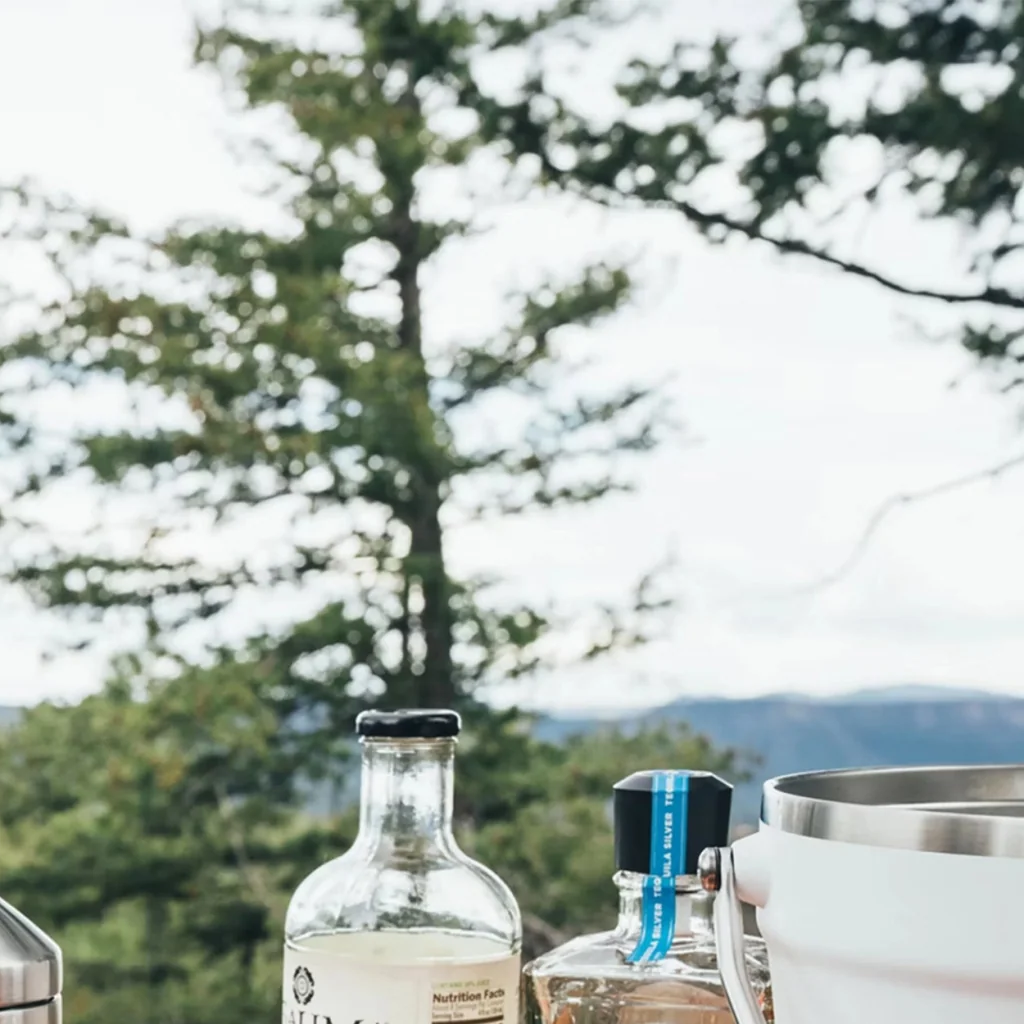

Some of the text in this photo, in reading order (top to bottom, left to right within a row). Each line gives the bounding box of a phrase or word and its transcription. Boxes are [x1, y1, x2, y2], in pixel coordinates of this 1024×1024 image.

[652, 903, 663, 939] SILVER
[663, 812, 674, 850] SILVER
[433, 991, 482, 1004] Nutrition
